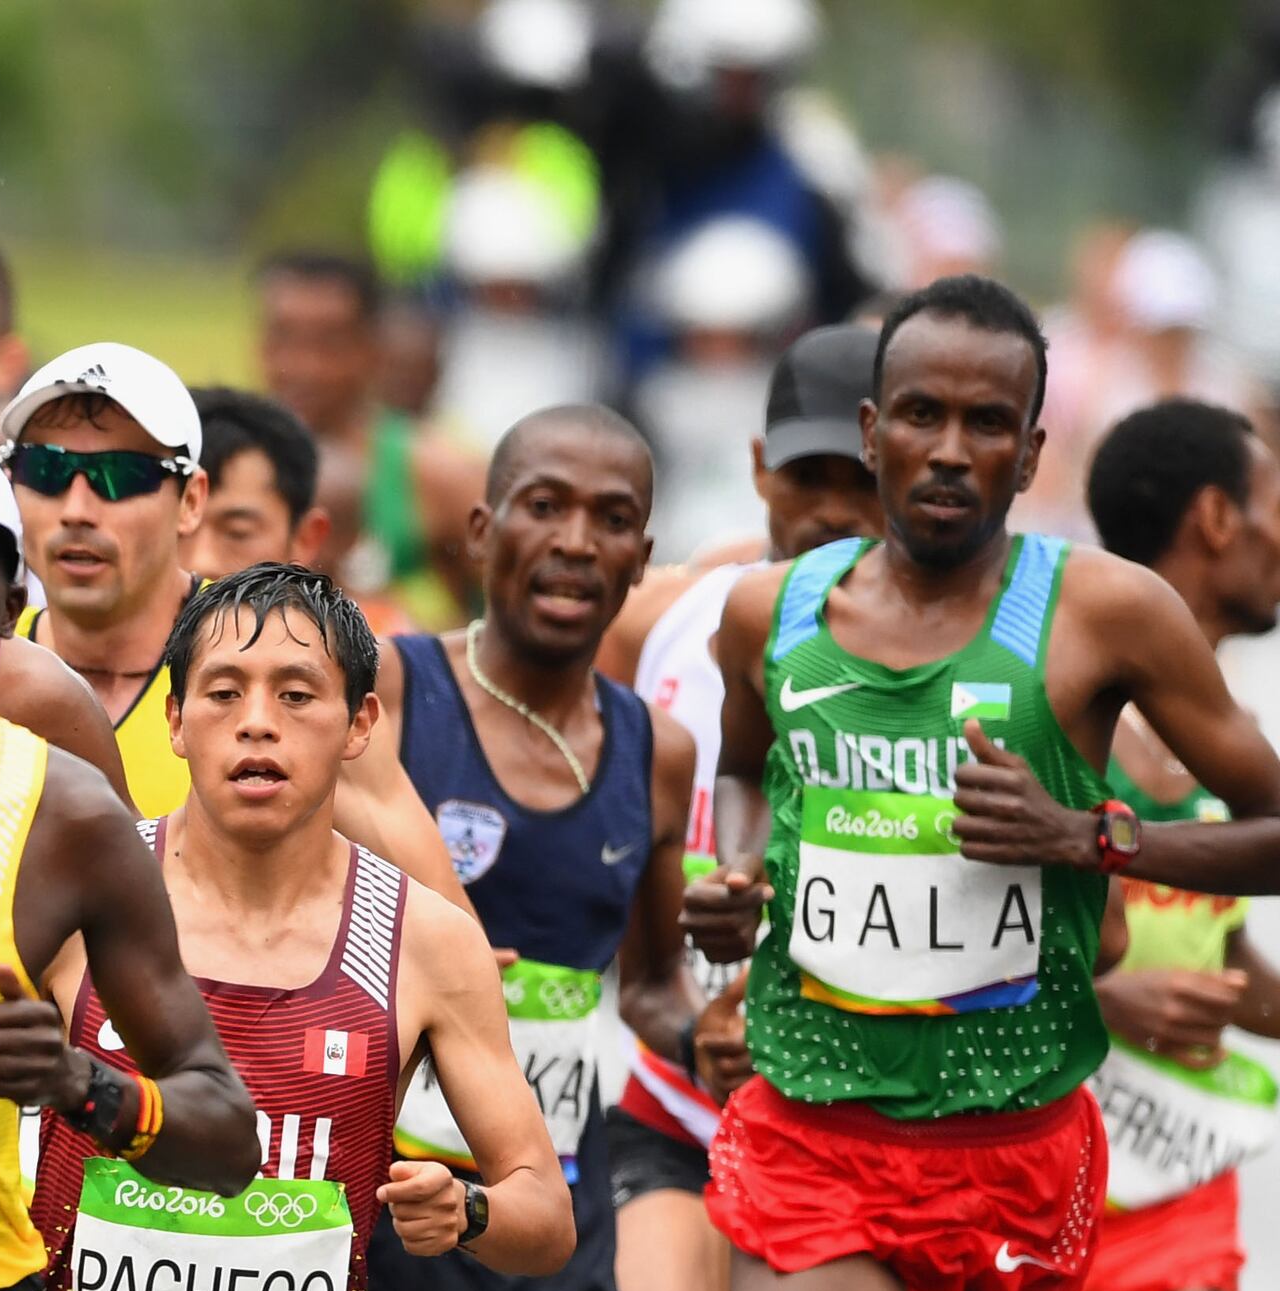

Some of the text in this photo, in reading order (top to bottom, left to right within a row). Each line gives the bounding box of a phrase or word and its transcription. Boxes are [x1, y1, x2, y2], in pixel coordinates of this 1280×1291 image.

[824, 805, 919, 840] Rio2016
[801, 876, 1036, 953] GALA
[114, 1179, 226, 1218] Rio2016
